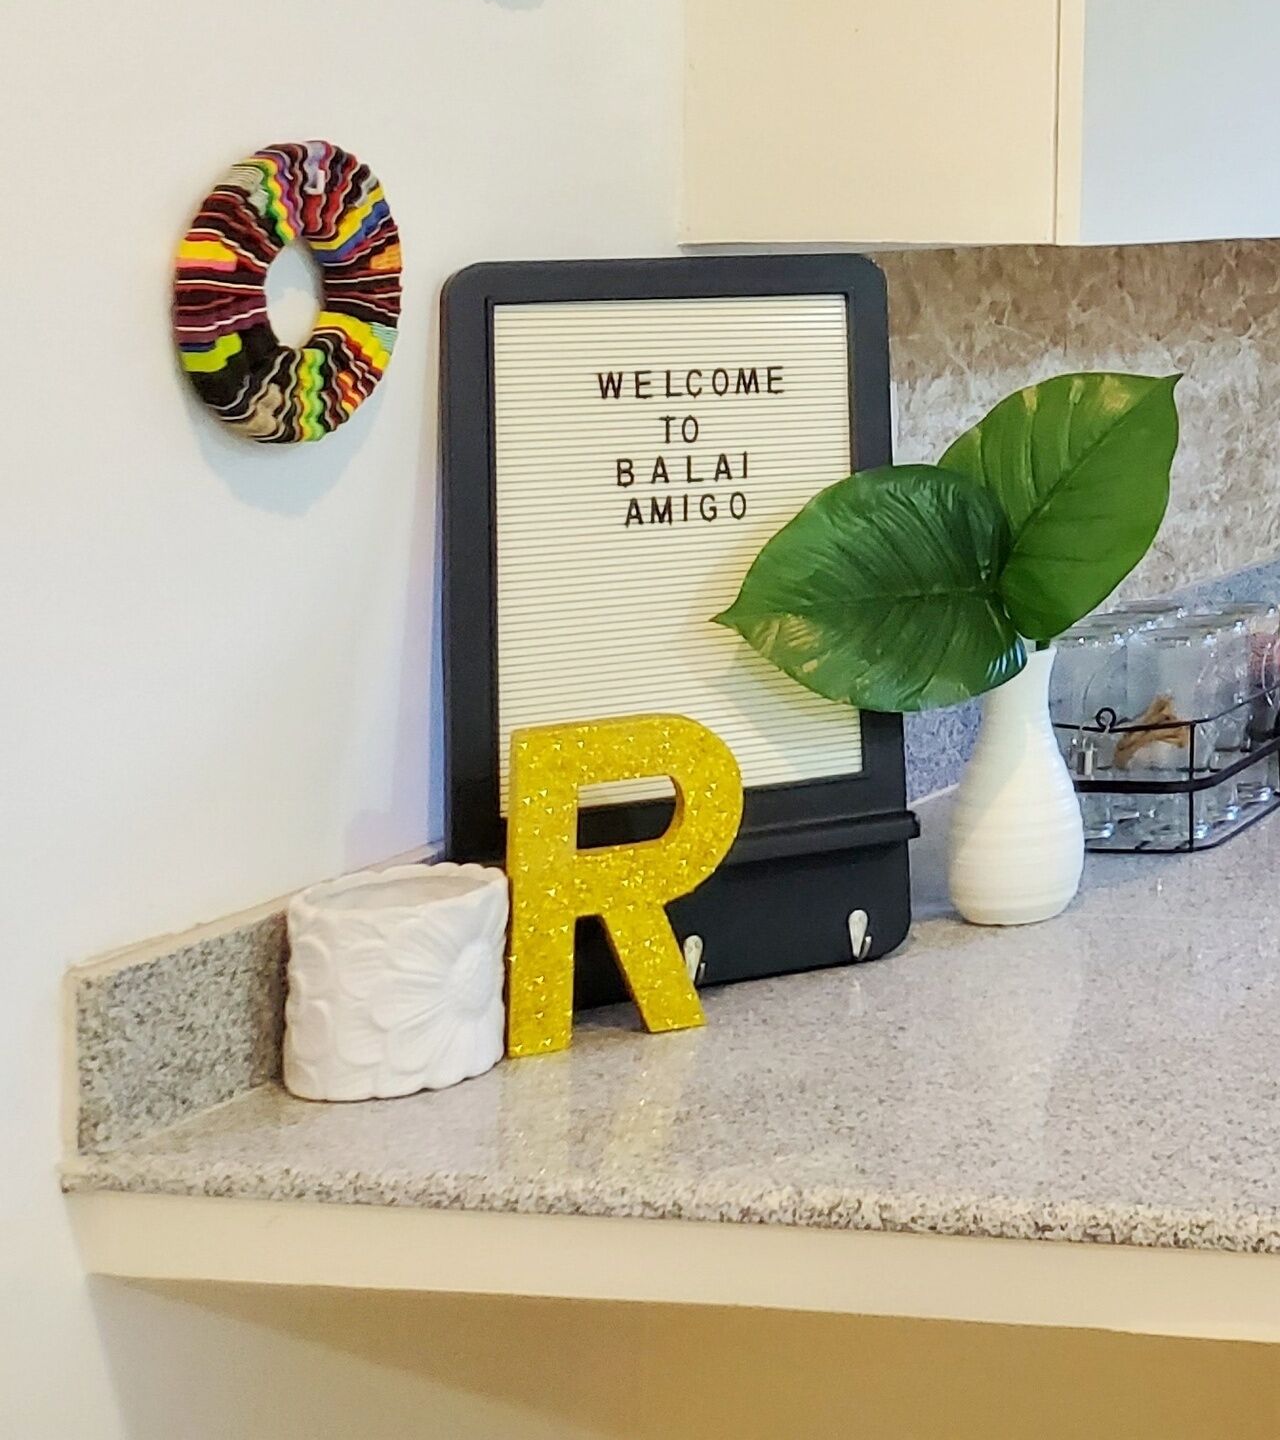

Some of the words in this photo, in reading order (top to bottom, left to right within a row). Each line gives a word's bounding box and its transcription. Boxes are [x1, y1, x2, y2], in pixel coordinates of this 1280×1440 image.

[598, 366, 784, 399] WELCOME
[658, 415, 699, 444] TO
[616, 451, 748, 488] BALAI
[624, 491, 747, 528] AMIGO
[506, 713, 744, 1059] R
